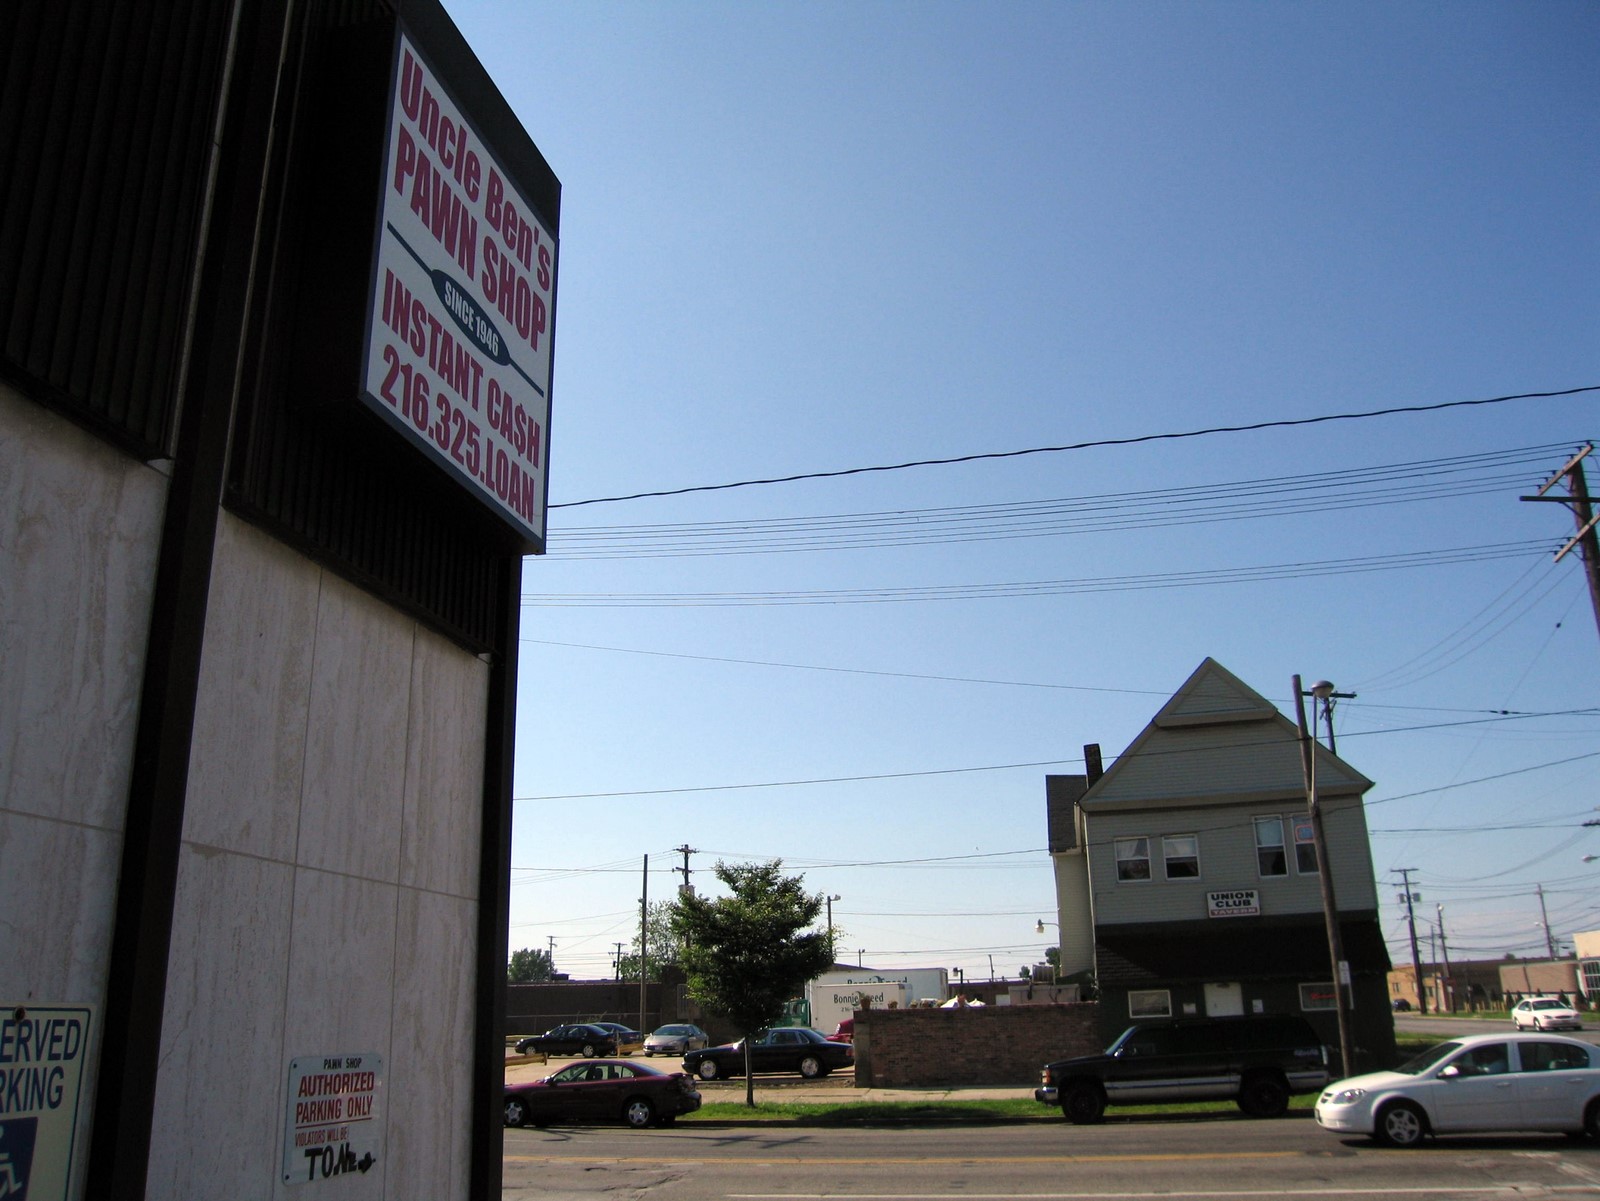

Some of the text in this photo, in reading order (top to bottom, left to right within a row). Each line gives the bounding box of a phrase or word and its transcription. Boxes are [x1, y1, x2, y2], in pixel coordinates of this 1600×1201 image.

[400, 48, 551, 291] Uncle Ben's
[394, 122, 546, 352] PAWN SHOP
[444, 280, 499, 357] SINCE 1946
[381, 267, 541, 470] INSTANT CA$H
[1210, 891, 1255, 901] UNION
[1215, 899, 1252, 909] CLUB
[833, 991, 860, 1005] Bonnie
[323, 1057, 362, 1070] PAWN SHOP
[298, 1071, 375, 1098] AUTHORIZED
[295, 1095, 374, 1124] PARKING ONLY
[295, 1129, 326, 1147] VIOLATORS
[327, 1127, 340, 1142] WILL
